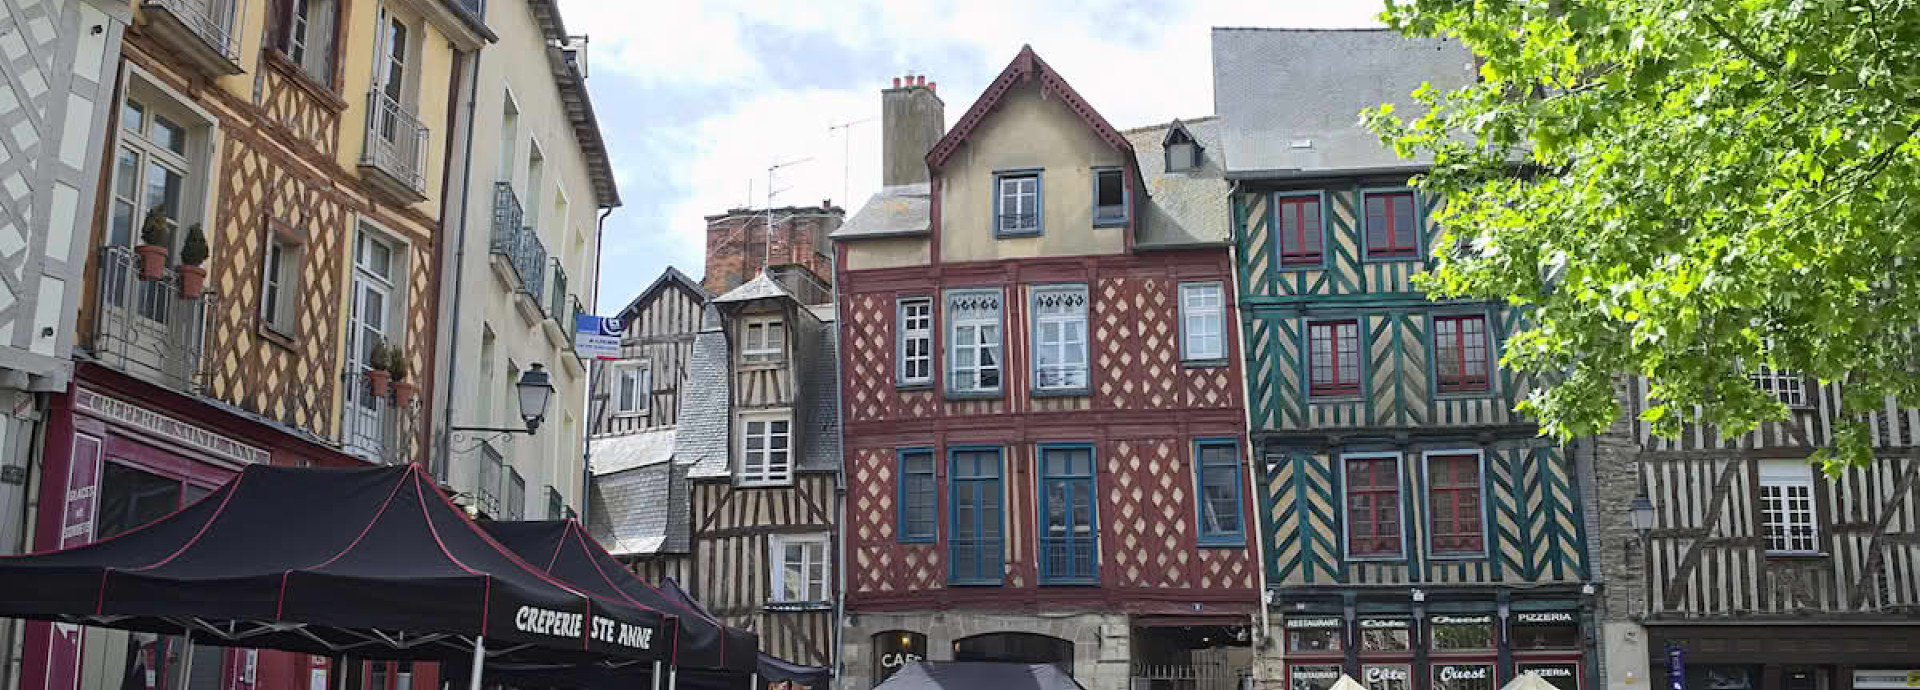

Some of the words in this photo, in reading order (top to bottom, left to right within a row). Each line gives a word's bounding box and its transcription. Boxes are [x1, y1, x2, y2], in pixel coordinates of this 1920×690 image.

[1287, 619, 1339, 628] RESTAURANT
[1518, 613, 1572, 622] PIZZERIA
[516, 605, 583, 637] CREPERIE
[591, 615, 615, 643] STE
[618, 622, 653, 650] ANNE
[1441, 666, 1486, 681] Ouest
